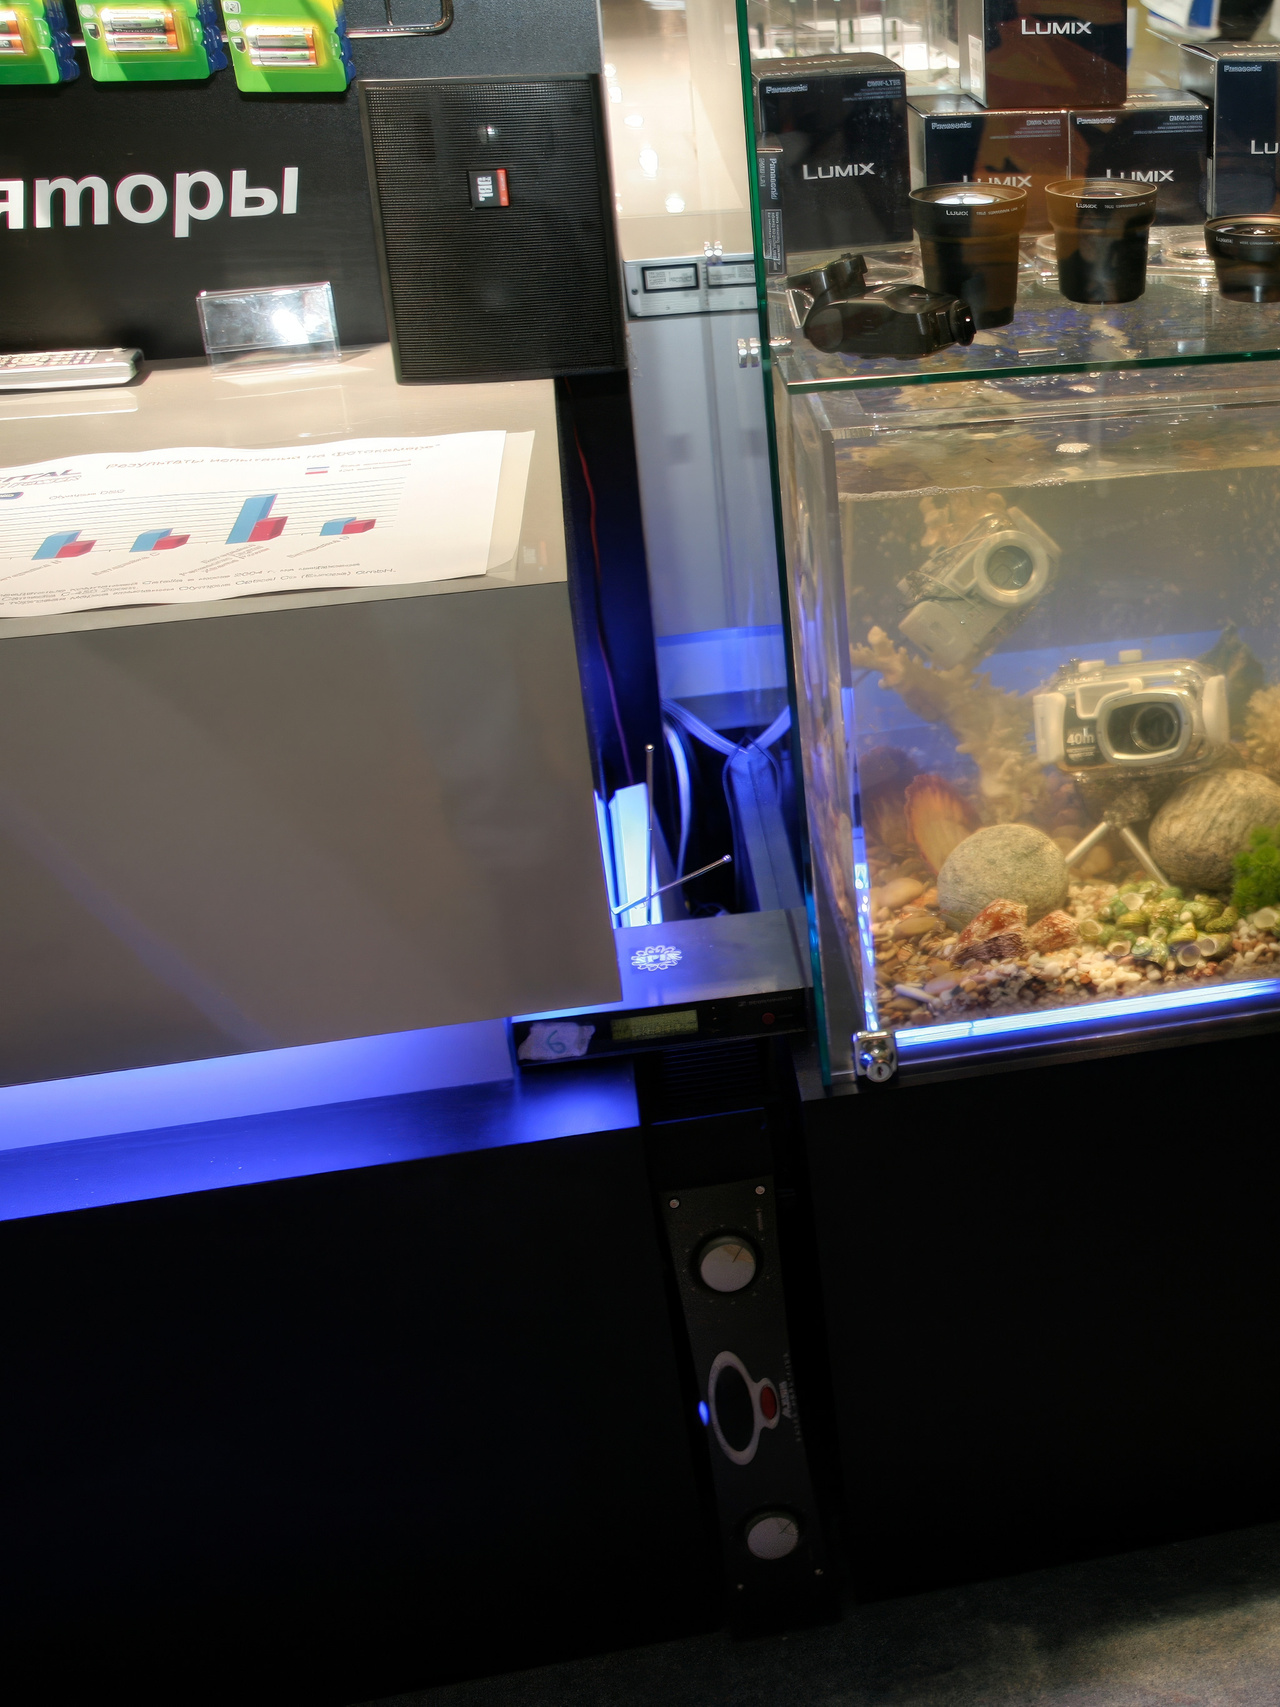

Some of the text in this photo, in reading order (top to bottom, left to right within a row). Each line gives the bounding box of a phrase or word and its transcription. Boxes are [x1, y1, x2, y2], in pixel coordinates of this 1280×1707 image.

[1021, 19, 1092, 35] LUMIX
[765, 83, 809, 94] Panasonic
[931, 121, 973, 130] Panasonic
[1076, 116, 1116, 125] Panasonic
[802, 161, 876, 180] LUMIX
[546, 1029, 567, 1054] 6
